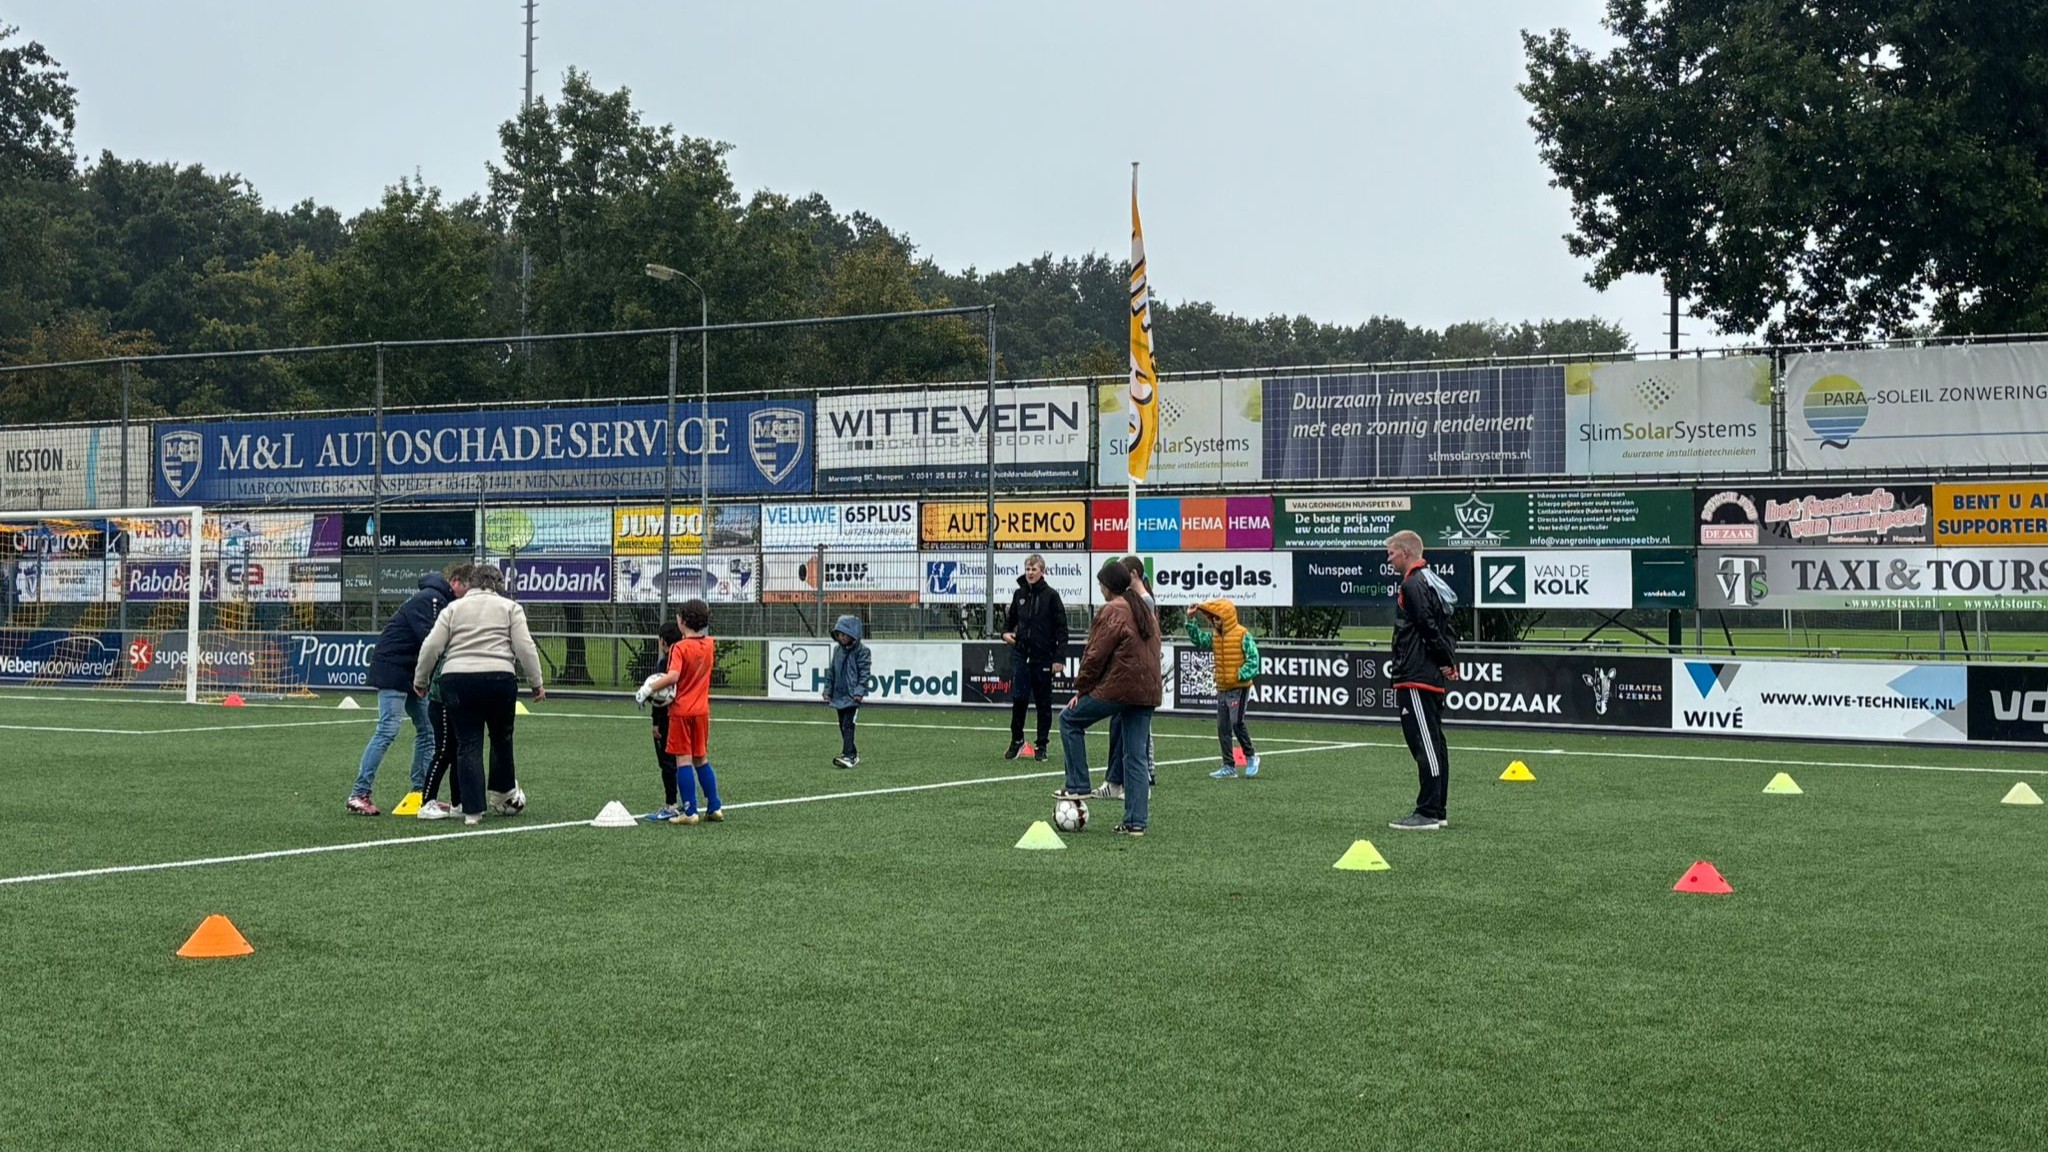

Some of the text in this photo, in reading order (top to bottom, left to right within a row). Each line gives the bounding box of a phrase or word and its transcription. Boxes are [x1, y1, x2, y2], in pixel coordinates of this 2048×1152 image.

[1292, 388, 1481, 411] Duurzaam investeren
[1939, 384, 2048, 402] ZONWERING
[829, 401, 1079, 438] WITTEVEEN
[1292, 413, 1534, 439] met een zonnig rendement
[1579, 420, 1757, 443] SlimSolarSystems
[217, 416, 730, 471] M&L AUTOSCHADESERVICE
[1110, 437, 1250, 456] SliolarSystems
[1622, 447, 1756, 459] duurzame installatietechnieken
[6, 448, 63, 473] NESTON
[1428, 449, 1531, 463] slimsolarsystems.nl
[237, 482, 329, 495] MARCONIWEG
[333, 481, 346, 493] 36
[525, 470, 701, 489] MENLAUTOSCHAD.NL
[1309, 501, 1352, 509] GRONINGEN
[1953, 495, 2001, 510] BENT
[2009, 493, 2021, 509] U
[767, 504, 912, 524] VELUWE 65PLUS
[947, 511, 1075, 533] AUTO-REMCO
[1093, 516, 1271, 532] HEMA HEMA HEMA HEMA
[1295, 513, 1396, 526] De beste prijs voor
[618, 513, 703, 538] JUMBO
[1314, 523, 1340, 534] oude
[1343, 523, 1390, 534] metalen!
[503, 565, 606, 592] Rabobank
[1044, 563, 1082, 576] echniek
[1308, 563, 1363, 578] Nunspeet
[1380, 563, 1401, 576] 05
[1534, 564, 1590, 578] VAN DE
[1791, 558, 2048, 591] TAXI & TOURS
[1341, 581, 1402, 598] 01nergiegla
[1534, 579, 1590, 595] KOLK
[1851, 597, 2048, 610] www.vtstaxi.nl www.vtstours.
[155, 645, 255, 670] supekeukens
[328, 671, 367, 685] wone
[1258, 657, 1350, 678] RKETING
[1357, 659, 1376, 679] IS
[1459, 662, 1503, 682] UXE
[812, 668, 958, 698] HpyFood
[1248, 685, 1350, 706] ARKETING
[1357, 687, 1376, 708] IS
[1446, 691, 1562, 714] OODZAAK
[1761, 691, 1956, 711] WWW.WIVE-TECHNIEK.NL
[1683, 706, 1744, 729] WIVÉ
